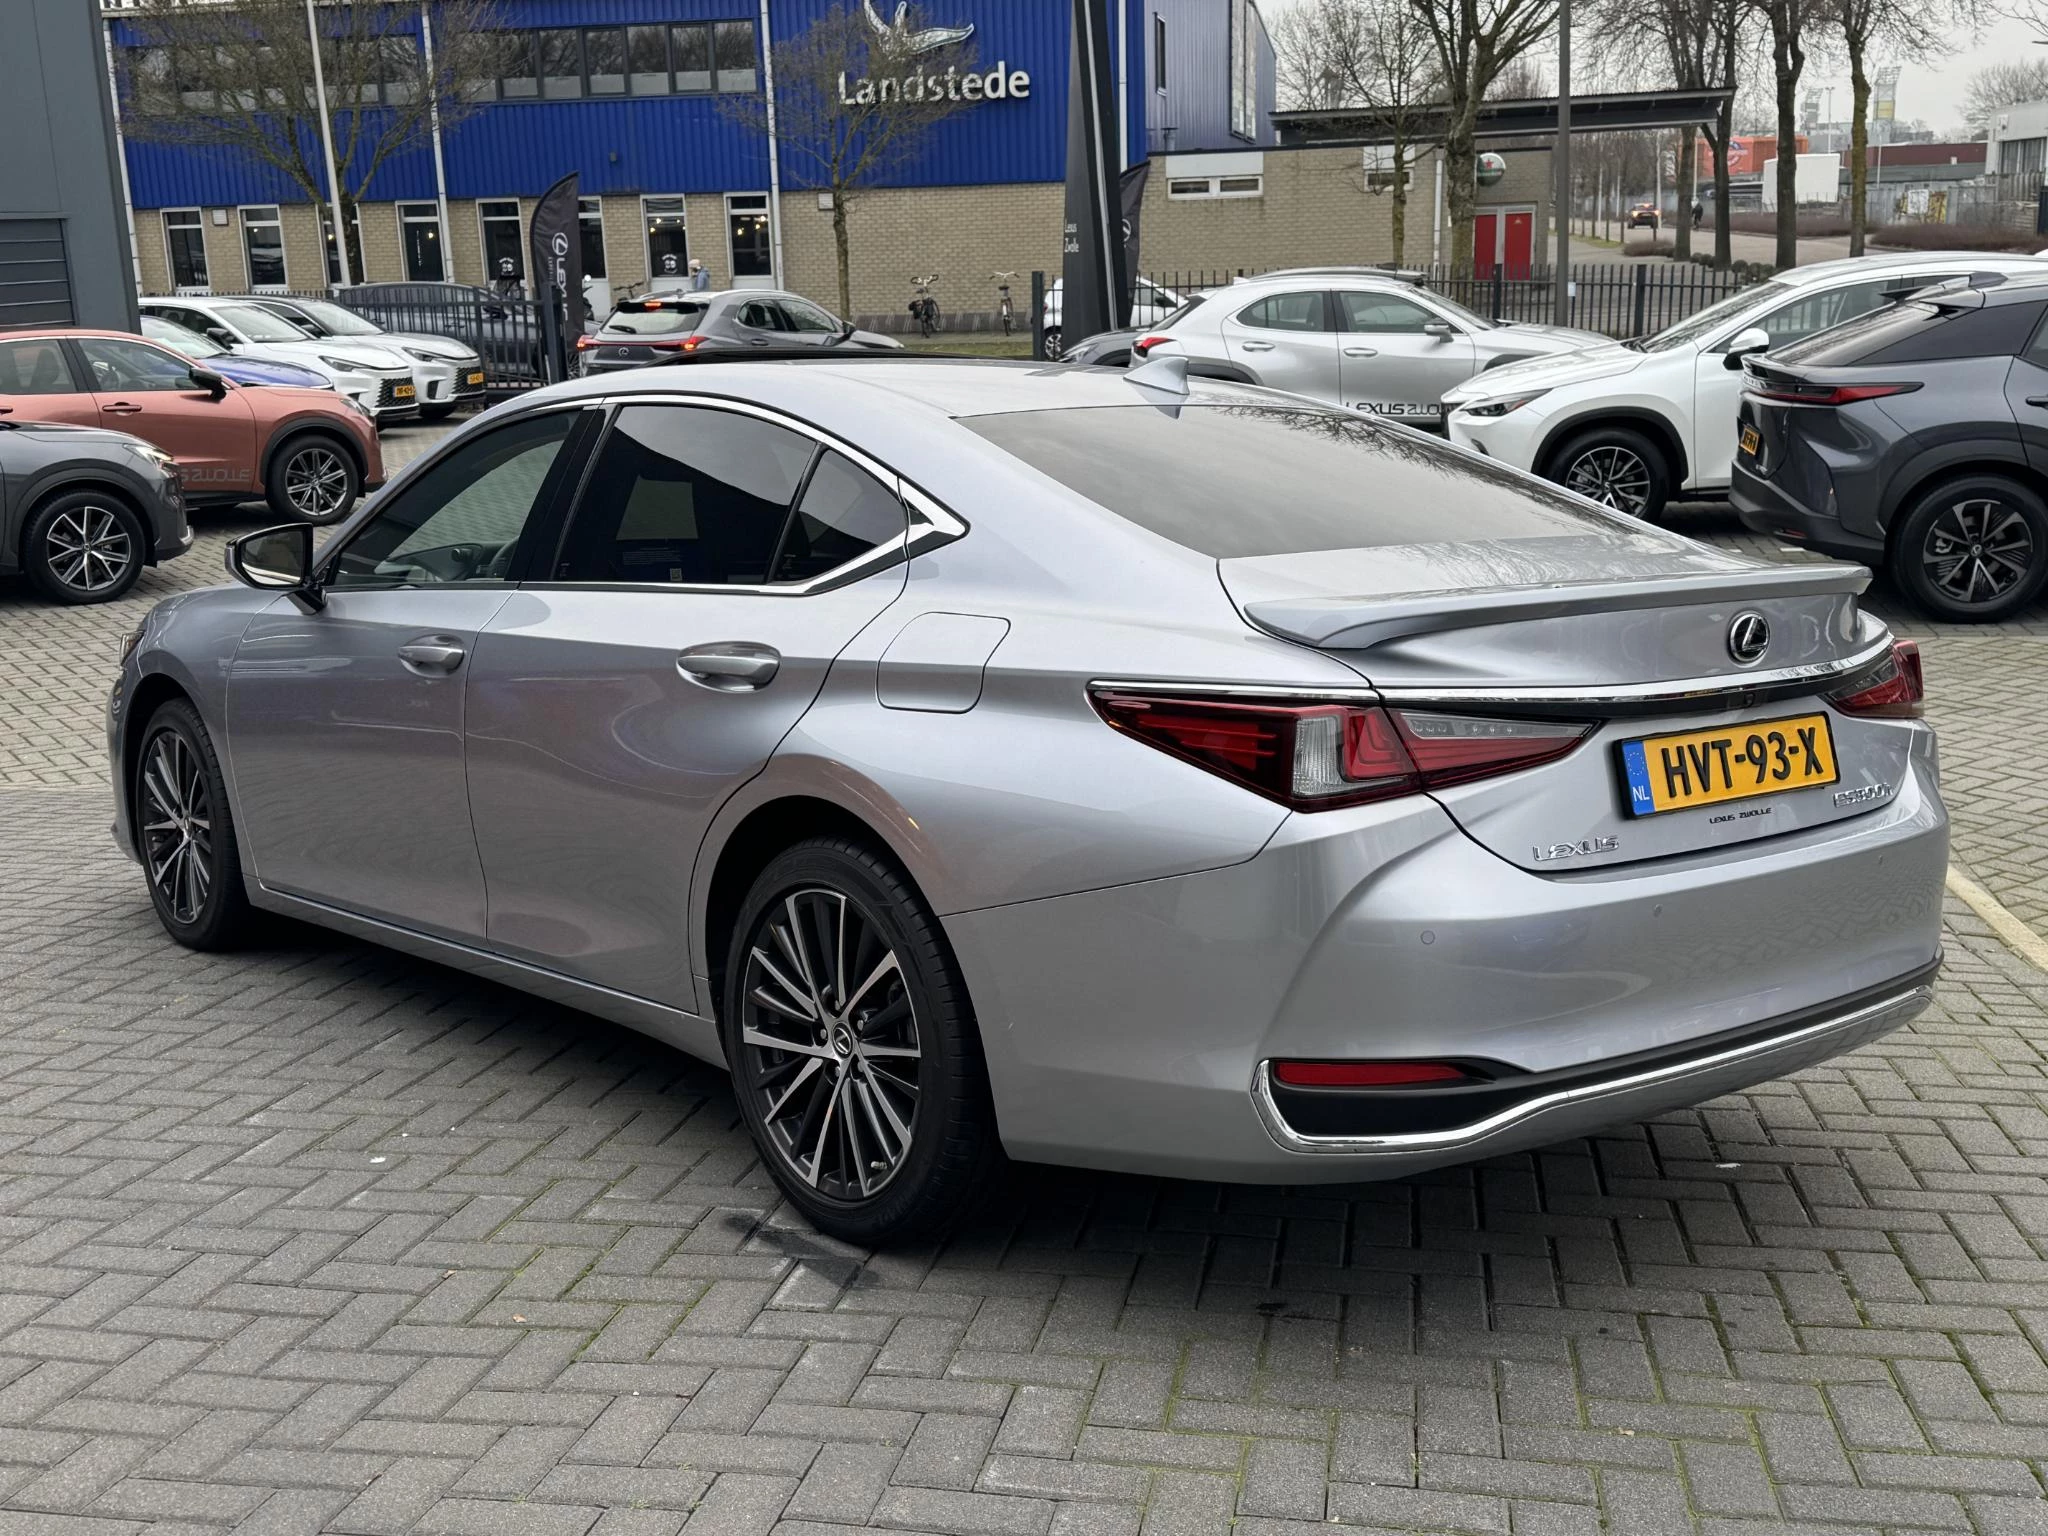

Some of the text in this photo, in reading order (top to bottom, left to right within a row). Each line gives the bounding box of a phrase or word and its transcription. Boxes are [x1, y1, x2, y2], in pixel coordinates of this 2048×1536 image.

[838, 60, 1031, 105] Landstede
[1345, 402, 1405, 415] EXUS
[1660, 726, 1824, 798] HVT-93-X
[1632, 785, 1650, 802] NL
[1709, 807, 1773, 824] LEXUS ZWOLLE
[1532, 834, 1620, 862] LEXUS
